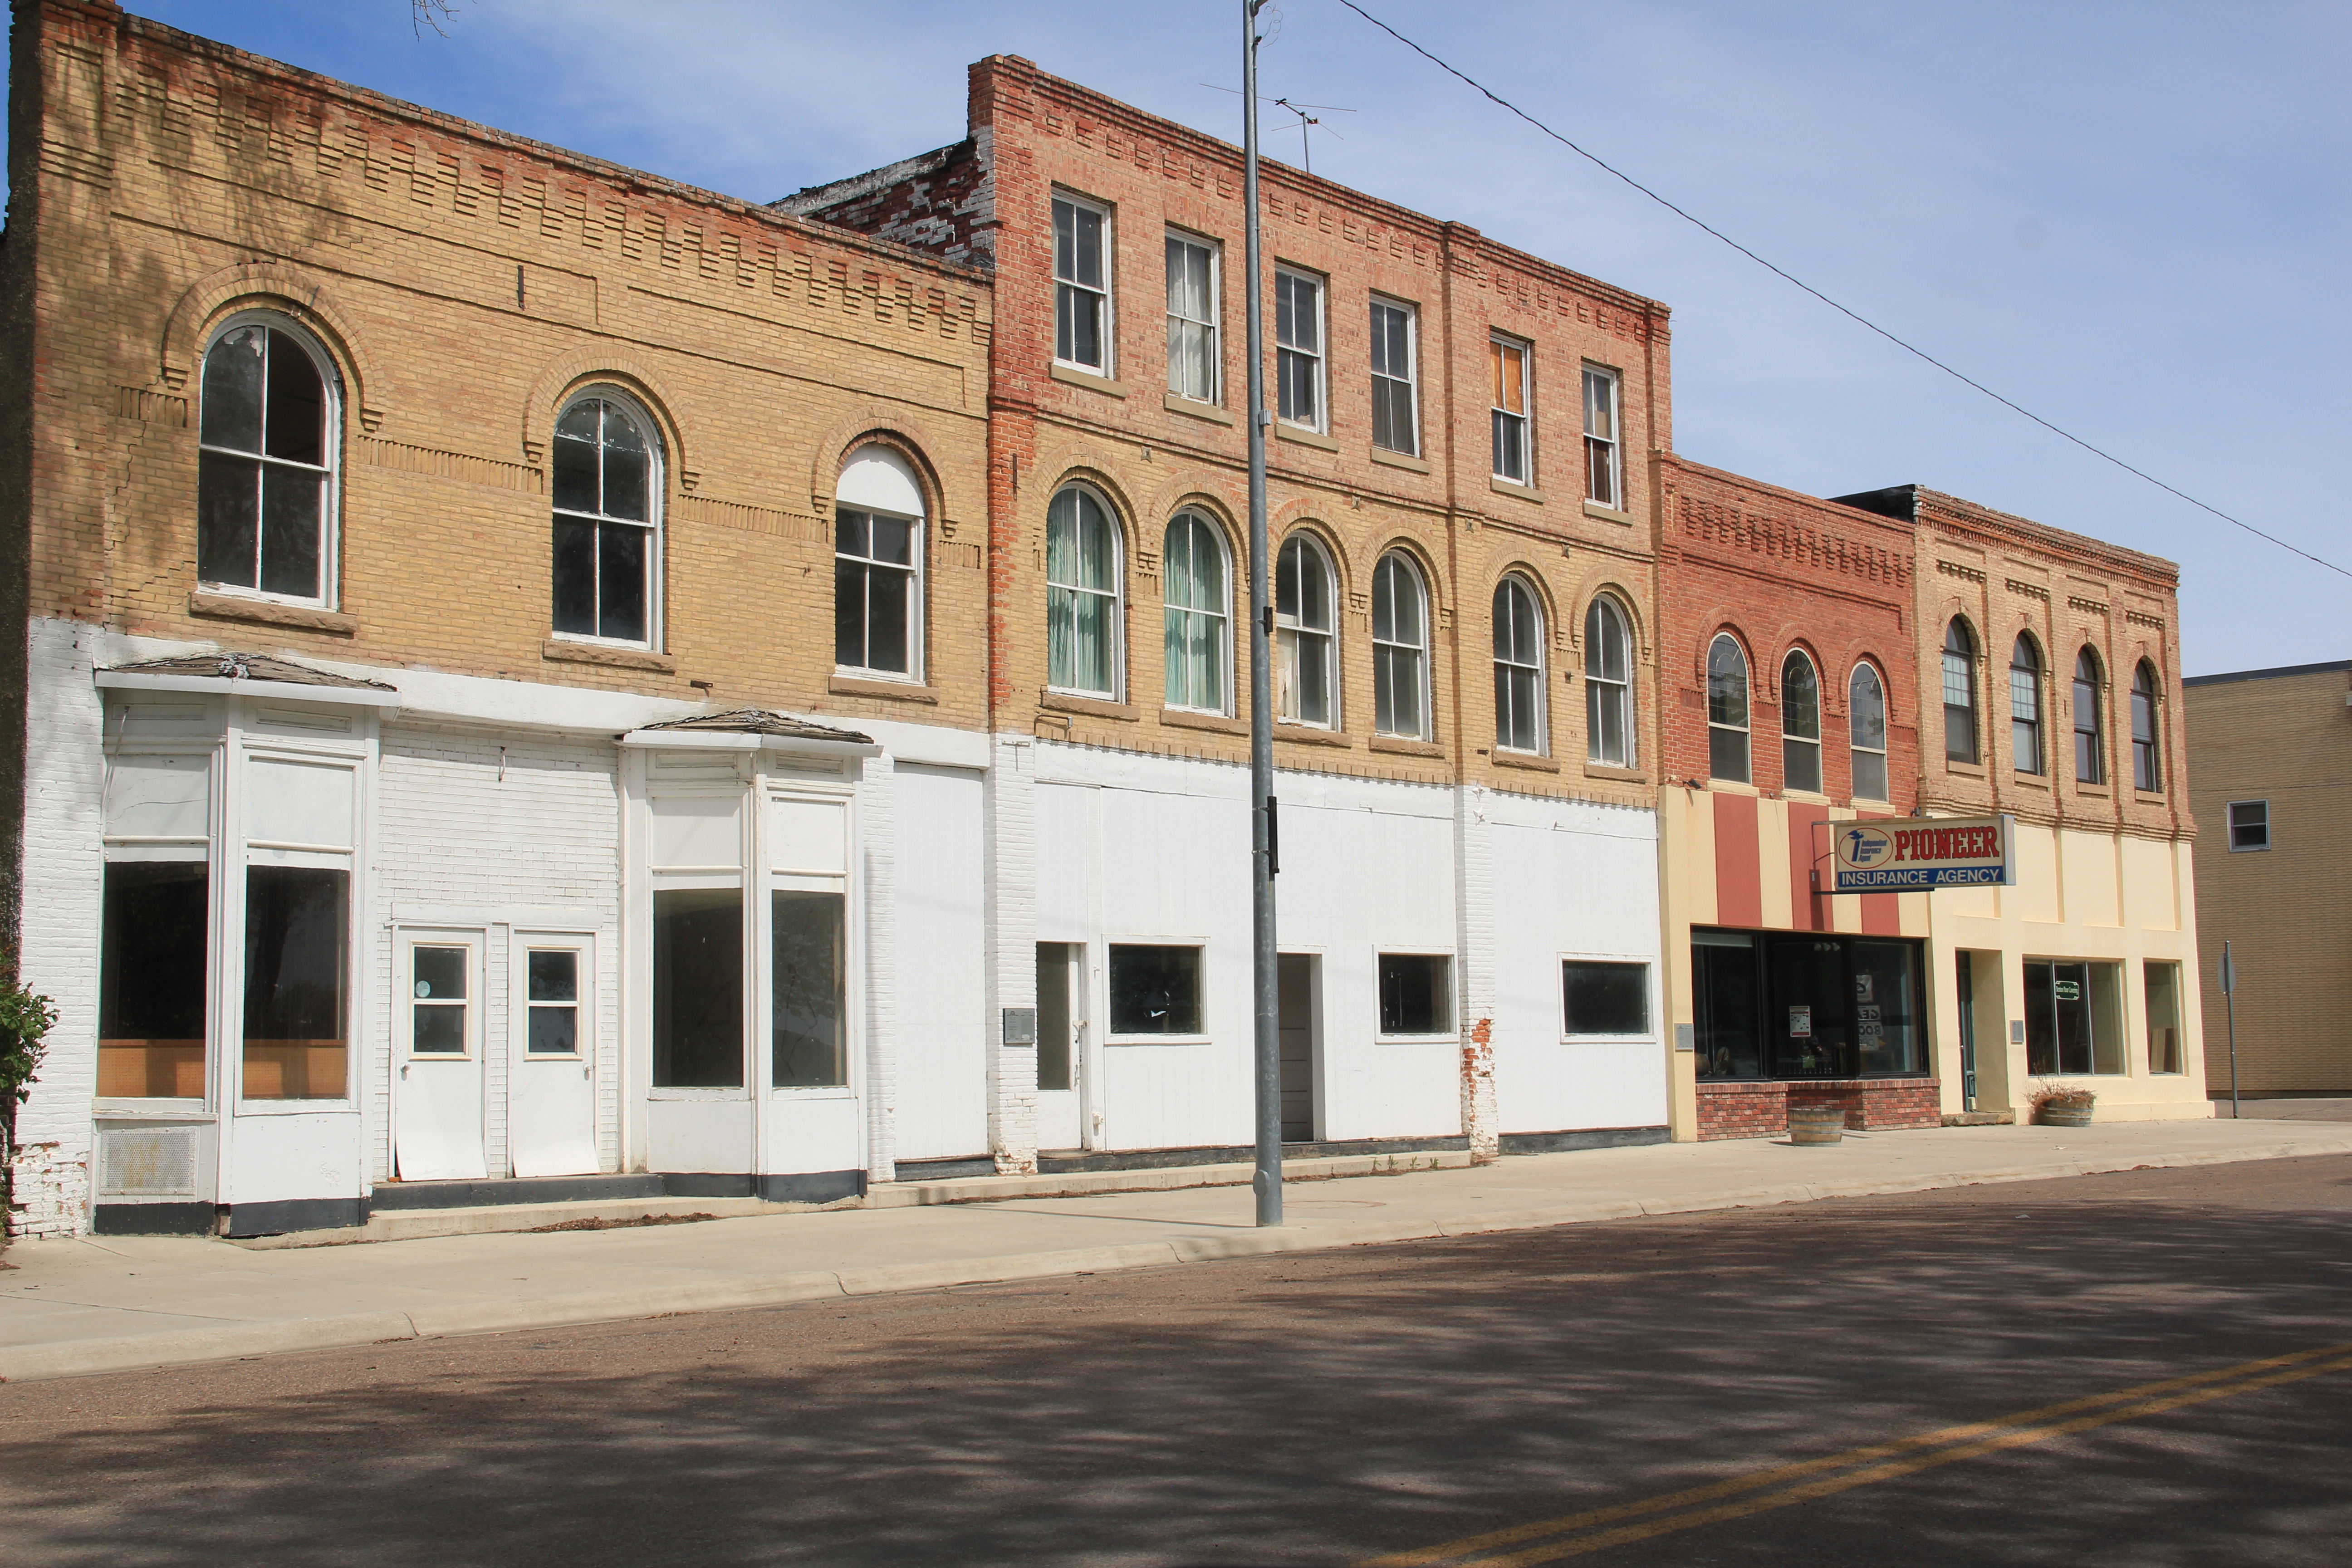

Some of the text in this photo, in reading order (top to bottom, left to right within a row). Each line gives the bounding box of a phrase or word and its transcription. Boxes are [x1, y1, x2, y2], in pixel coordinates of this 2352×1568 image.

[1862, 839, 1887, 848] Independent
[1894, 826, 1999, 861] PIONEER
[1858, 854, 1872, 862] Agent
[1842, 869, 1999, 885] INSURANCE AGENCY
